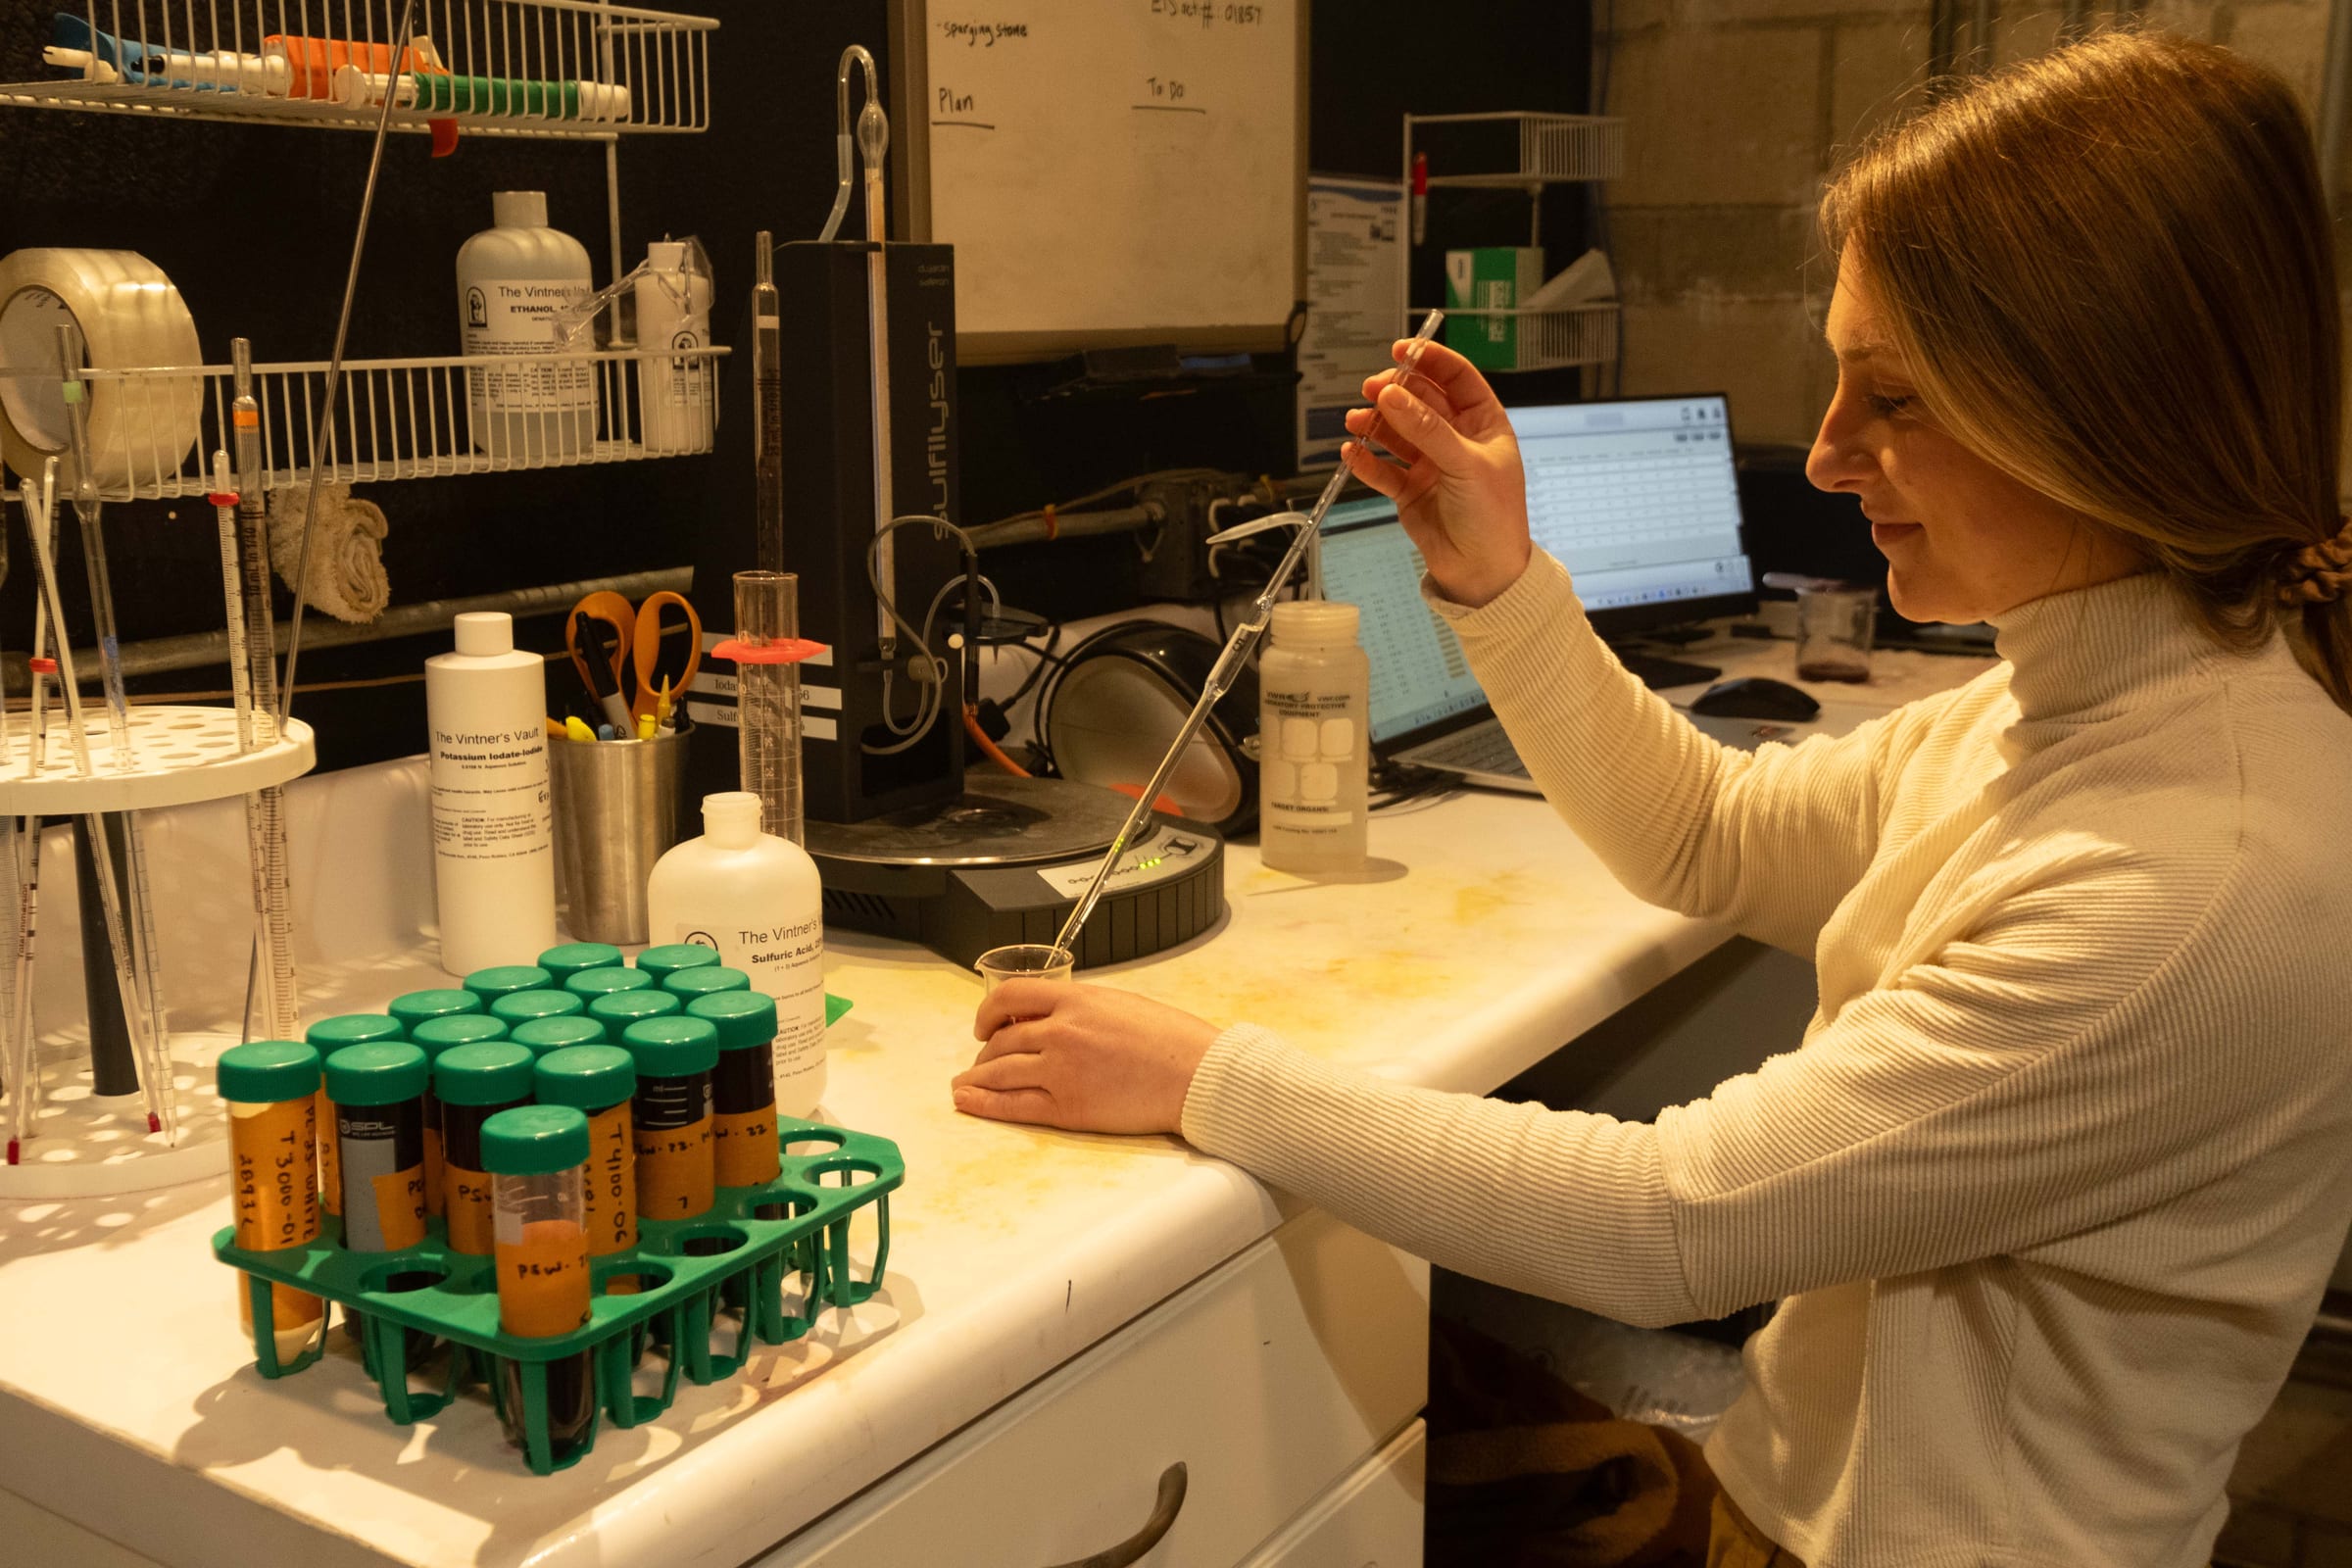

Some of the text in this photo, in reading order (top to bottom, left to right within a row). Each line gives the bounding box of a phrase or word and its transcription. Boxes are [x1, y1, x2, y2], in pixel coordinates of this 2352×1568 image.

[939, 88, 974, 114] Plan
[499, 286, 524, 298] The
[247, 565, 261, 582] mL
[435, 727, 539, 746] The Vintner's Vault
[440, 745, 543, 761] Potassium Iodate-Iodide
[738, 918, 819, 945] The Vintner's
[751, 948, 793, 964] Sulfuric
[351, 1120, 395, 1132] SPL
